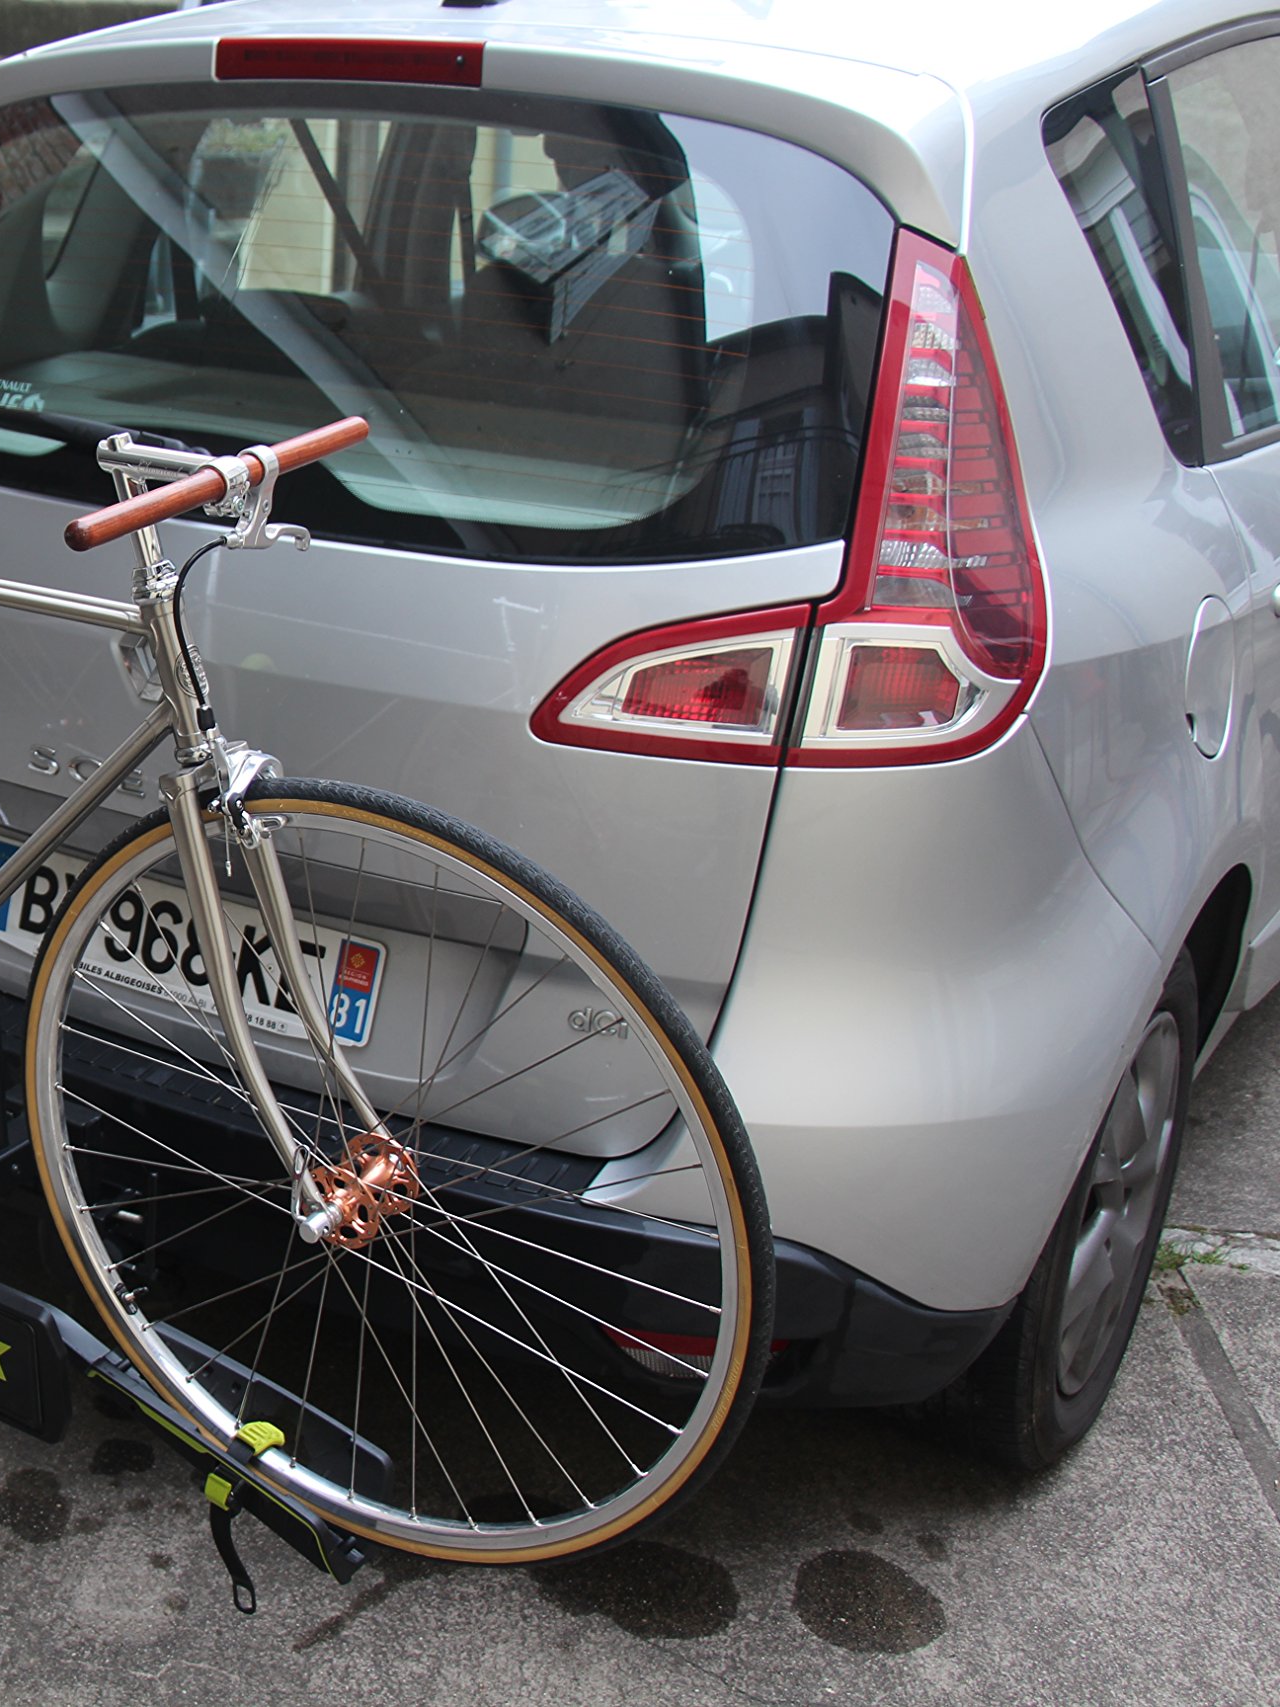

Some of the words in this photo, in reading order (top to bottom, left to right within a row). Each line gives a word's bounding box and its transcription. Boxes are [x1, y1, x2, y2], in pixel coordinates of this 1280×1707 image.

[18, 865, 77, 935] B
[103, 970, 163, 995] ALBIGEOISES
[329, 992, 367, 1035] 81
